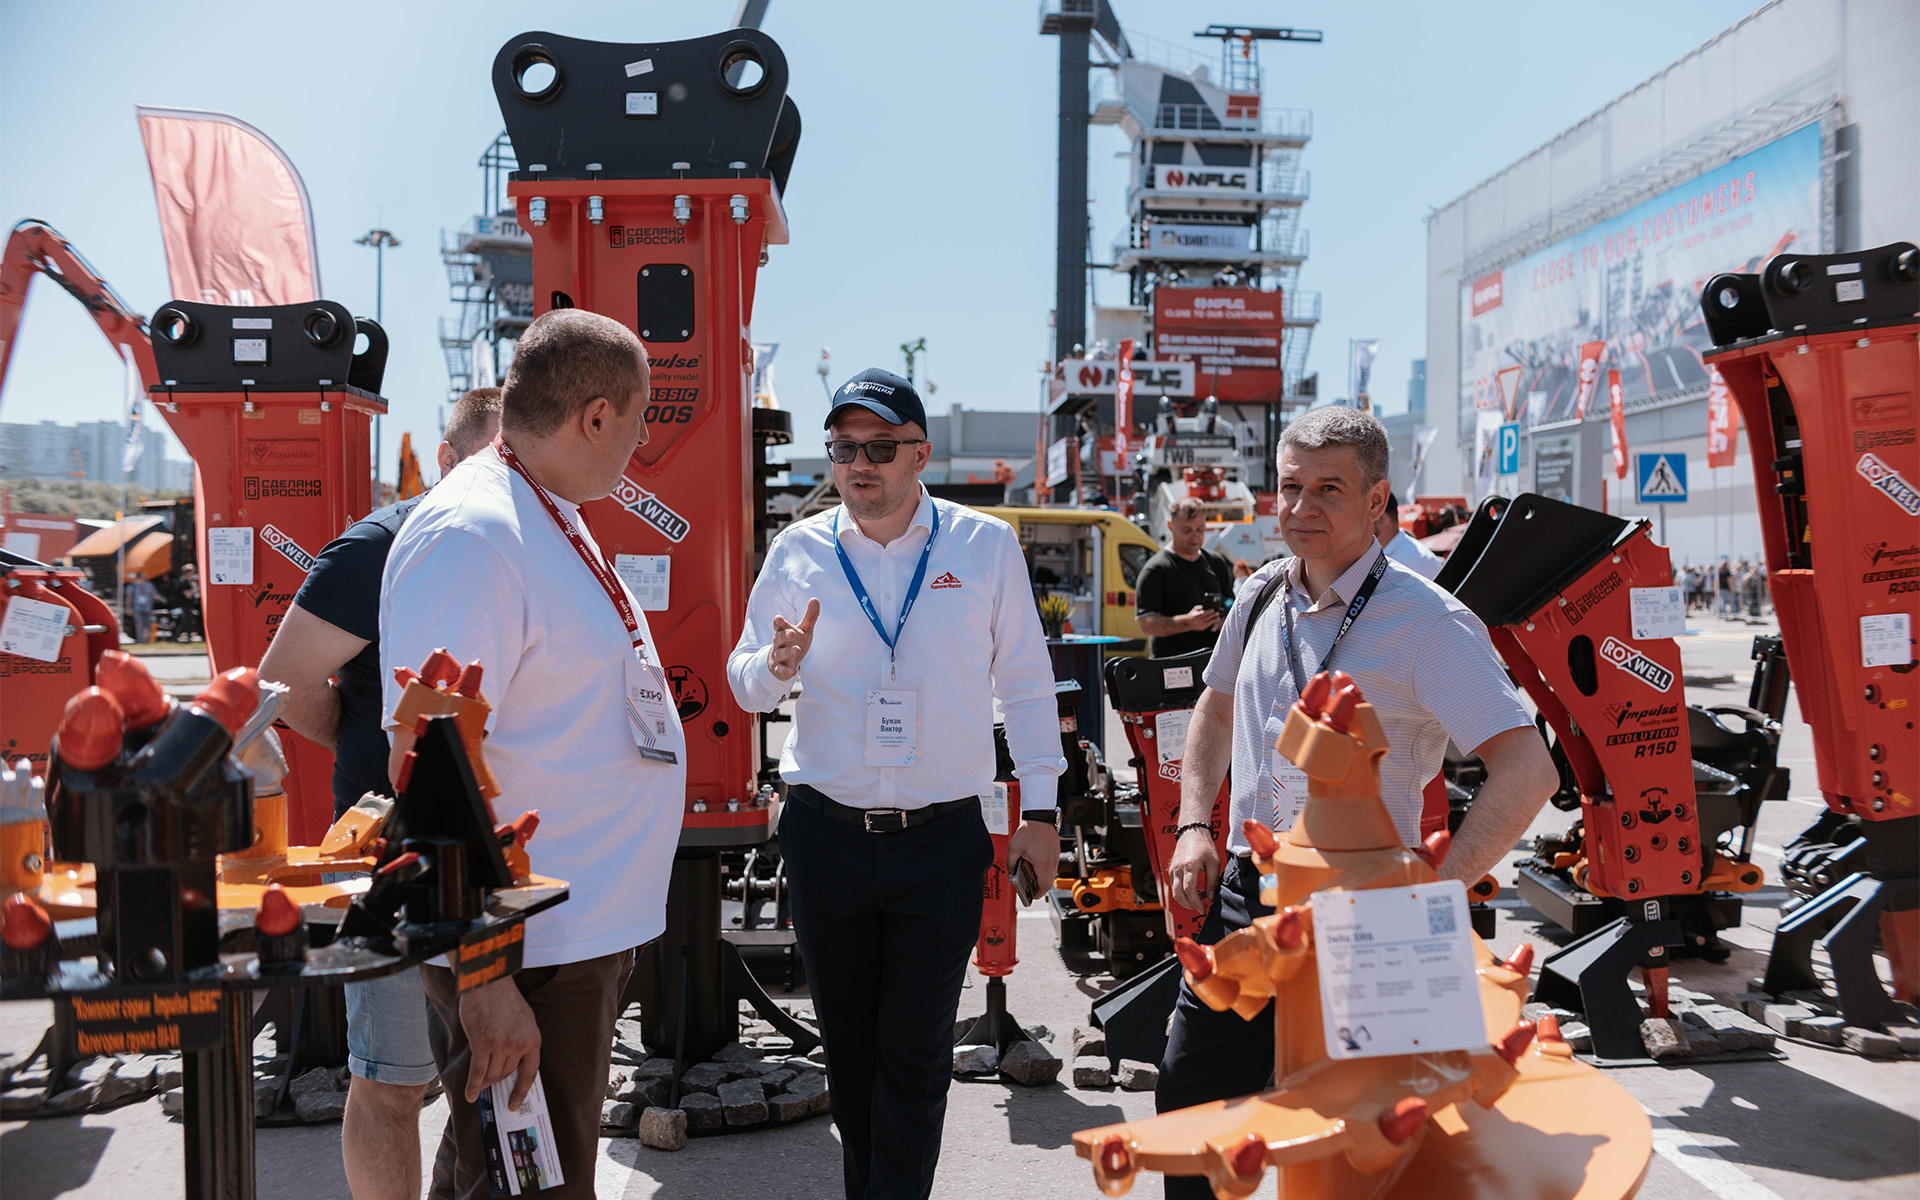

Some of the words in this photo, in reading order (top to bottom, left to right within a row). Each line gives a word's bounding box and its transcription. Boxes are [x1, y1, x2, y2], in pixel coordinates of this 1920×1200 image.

[1188, 172, 1246, 189] NFLG
[626, 227, 685, 236] СДЕЛАНО
[636, 236, 685, 245] РОССИИ
[1532, 252, 1575, 292] CLOSE
[1582, 243, 1599, 272] TO
[1604, 226, 1636, 263] OUR
[1641, 171, 1756, 247] CUSTOMERS
[1503, 427, 1516, 472] P
[262, 480, 322, 489] СДЕЛАНО
[272, 488, 322, 497] РОССИИ
[264, 527, 313, 570] ROXWELL
[1576, 571, 1619, 608] СДЕЛАНО
[1588, 577, 1624, 610] РОССИИ
[1350, 596, 1364, 616] CTO
[1604, 640, 1666, 688] ROXWELL
[882, 717, 901, 725] Бужак
[1617, 701, 1678, 728] impulse
[1608, 728, 1678, 745] EVOLUTION
[1634, 741, 1677, 758] R150
